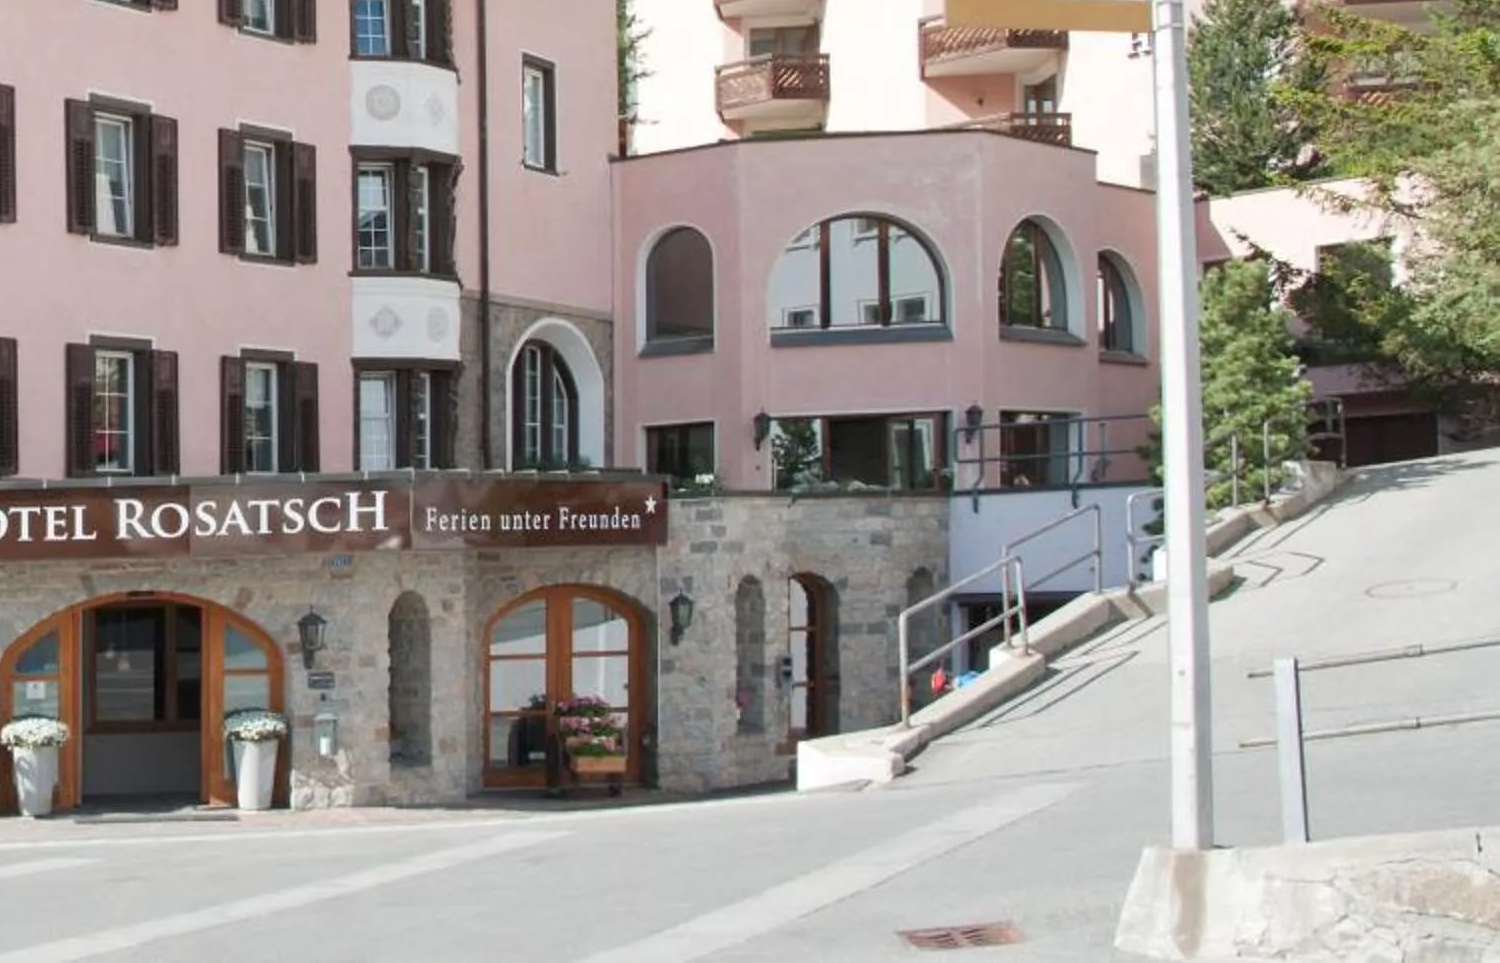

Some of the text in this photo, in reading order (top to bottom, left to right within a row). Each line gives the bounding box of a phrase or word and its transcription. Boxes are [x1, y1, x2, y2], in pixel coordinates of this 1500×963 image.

[113, 489, 390, 540] ROSATSCH
[425, 505, 641, 532] Ferien unter Freunden
